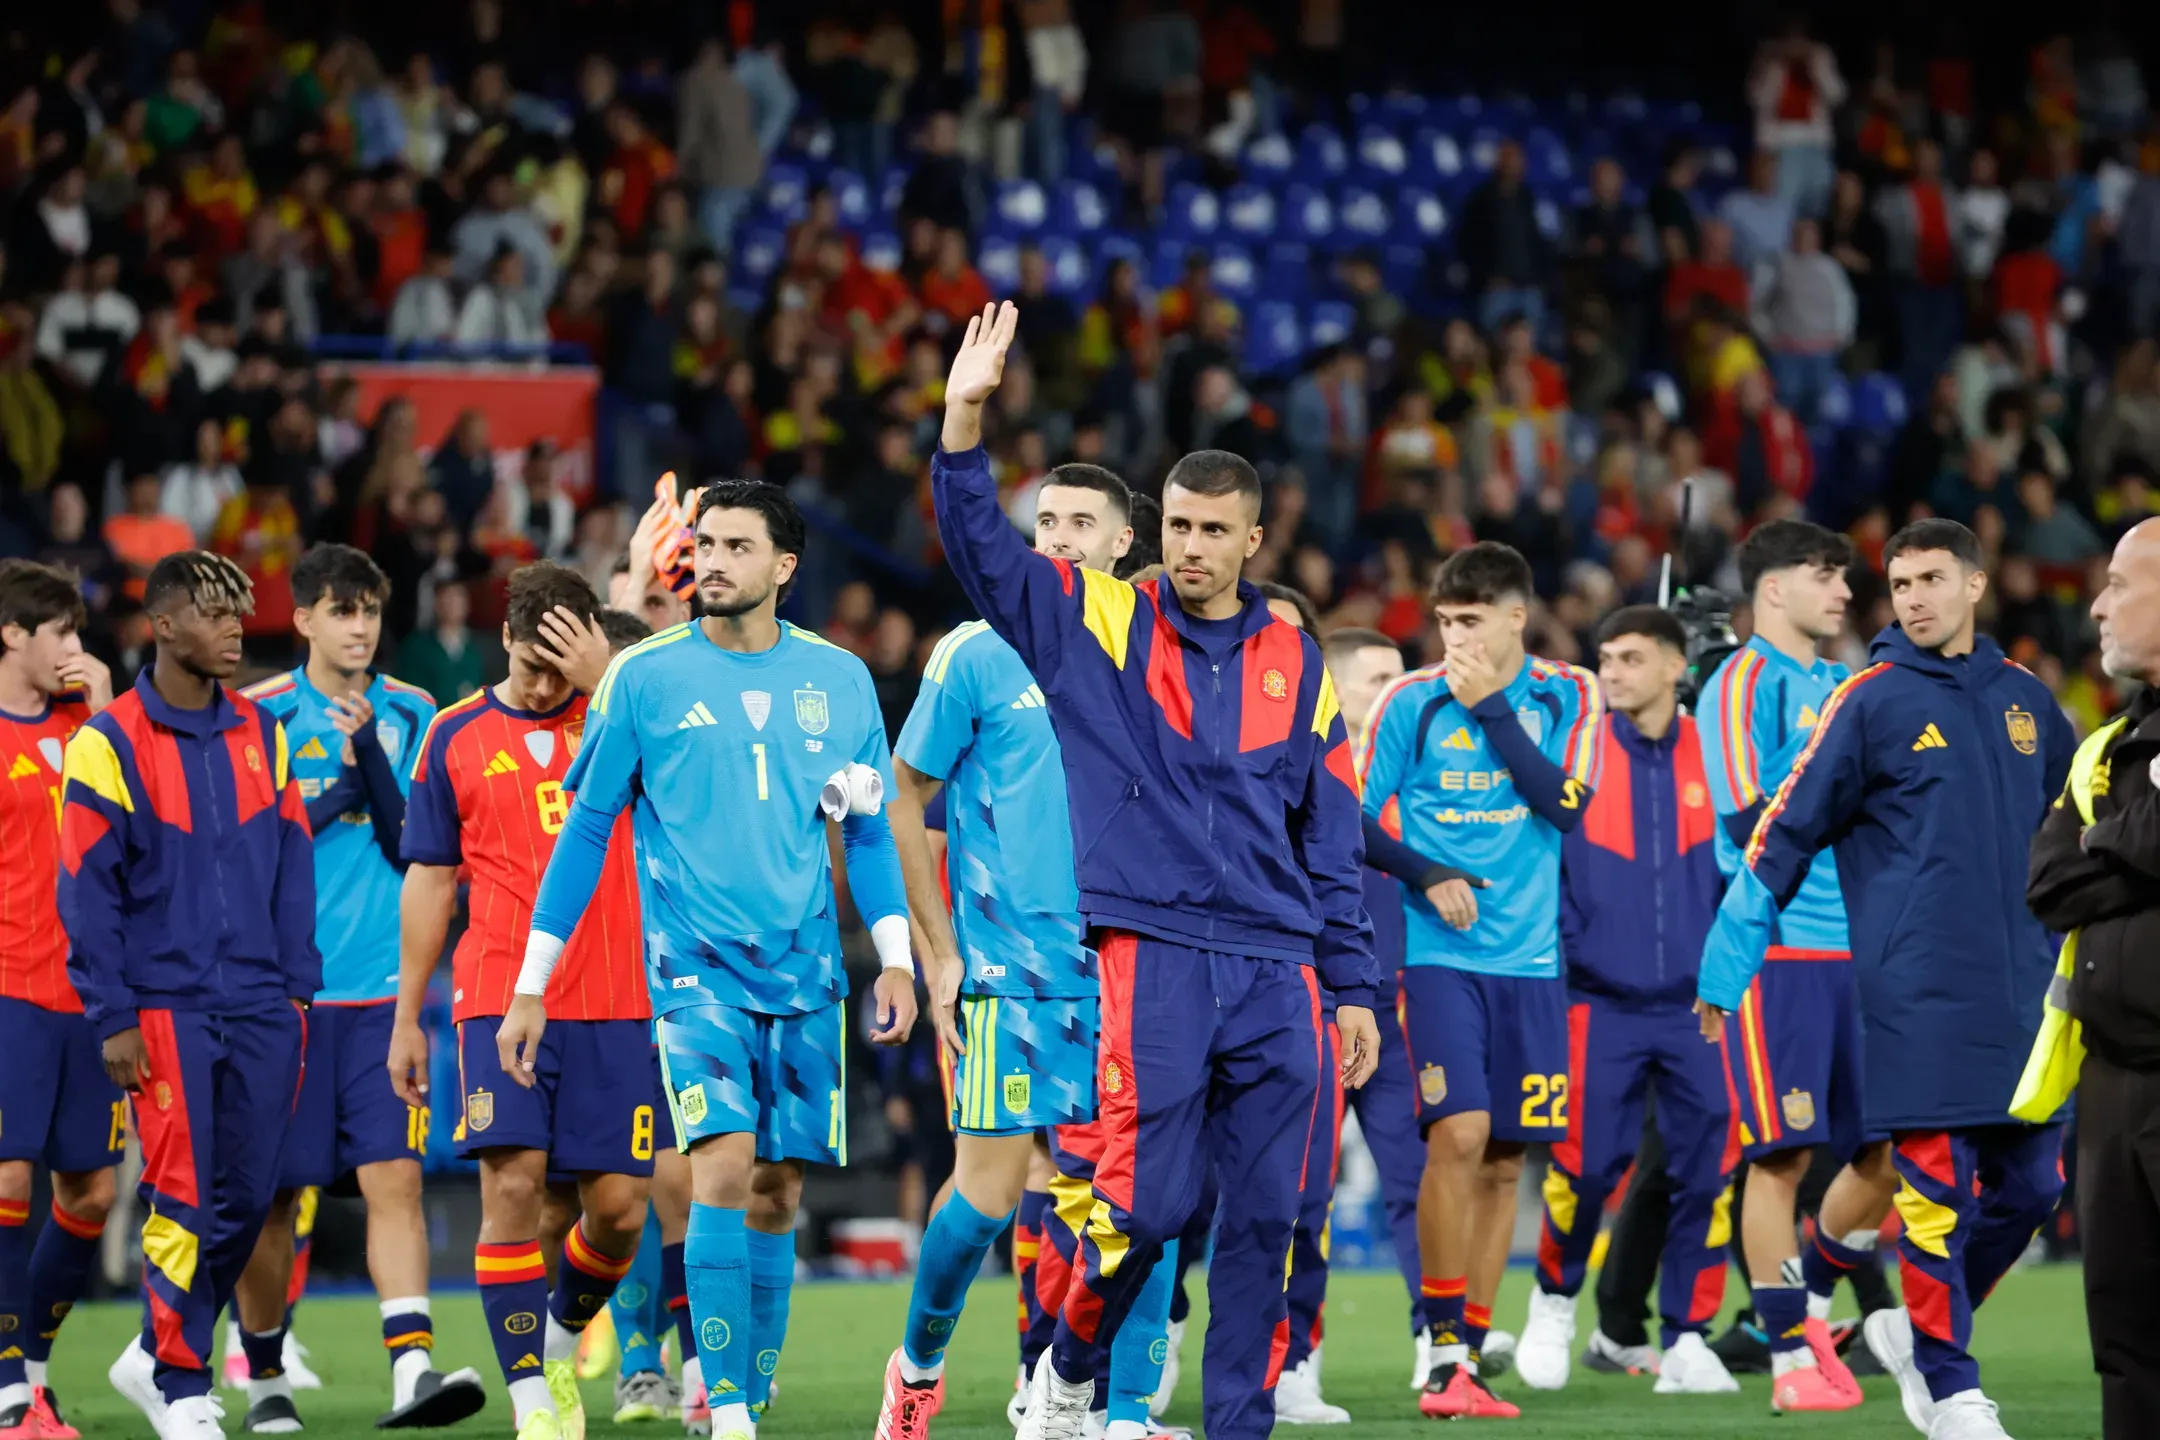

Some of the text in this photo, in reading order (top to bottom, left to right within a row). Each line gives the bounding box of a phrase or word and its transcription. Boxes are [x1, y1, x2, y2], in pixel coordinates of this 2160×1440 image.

[752, 744, 769, 800] 1
[535, 780, 569, 835] 8
[828, 1090, 838, 1148] 1
[1520, 1073, 1568, 1127] 22
[632, 1105, 654, 1160] 8
[706, 1324, 722, 1334] RF
[708, 1334, 723, 1345] EF
